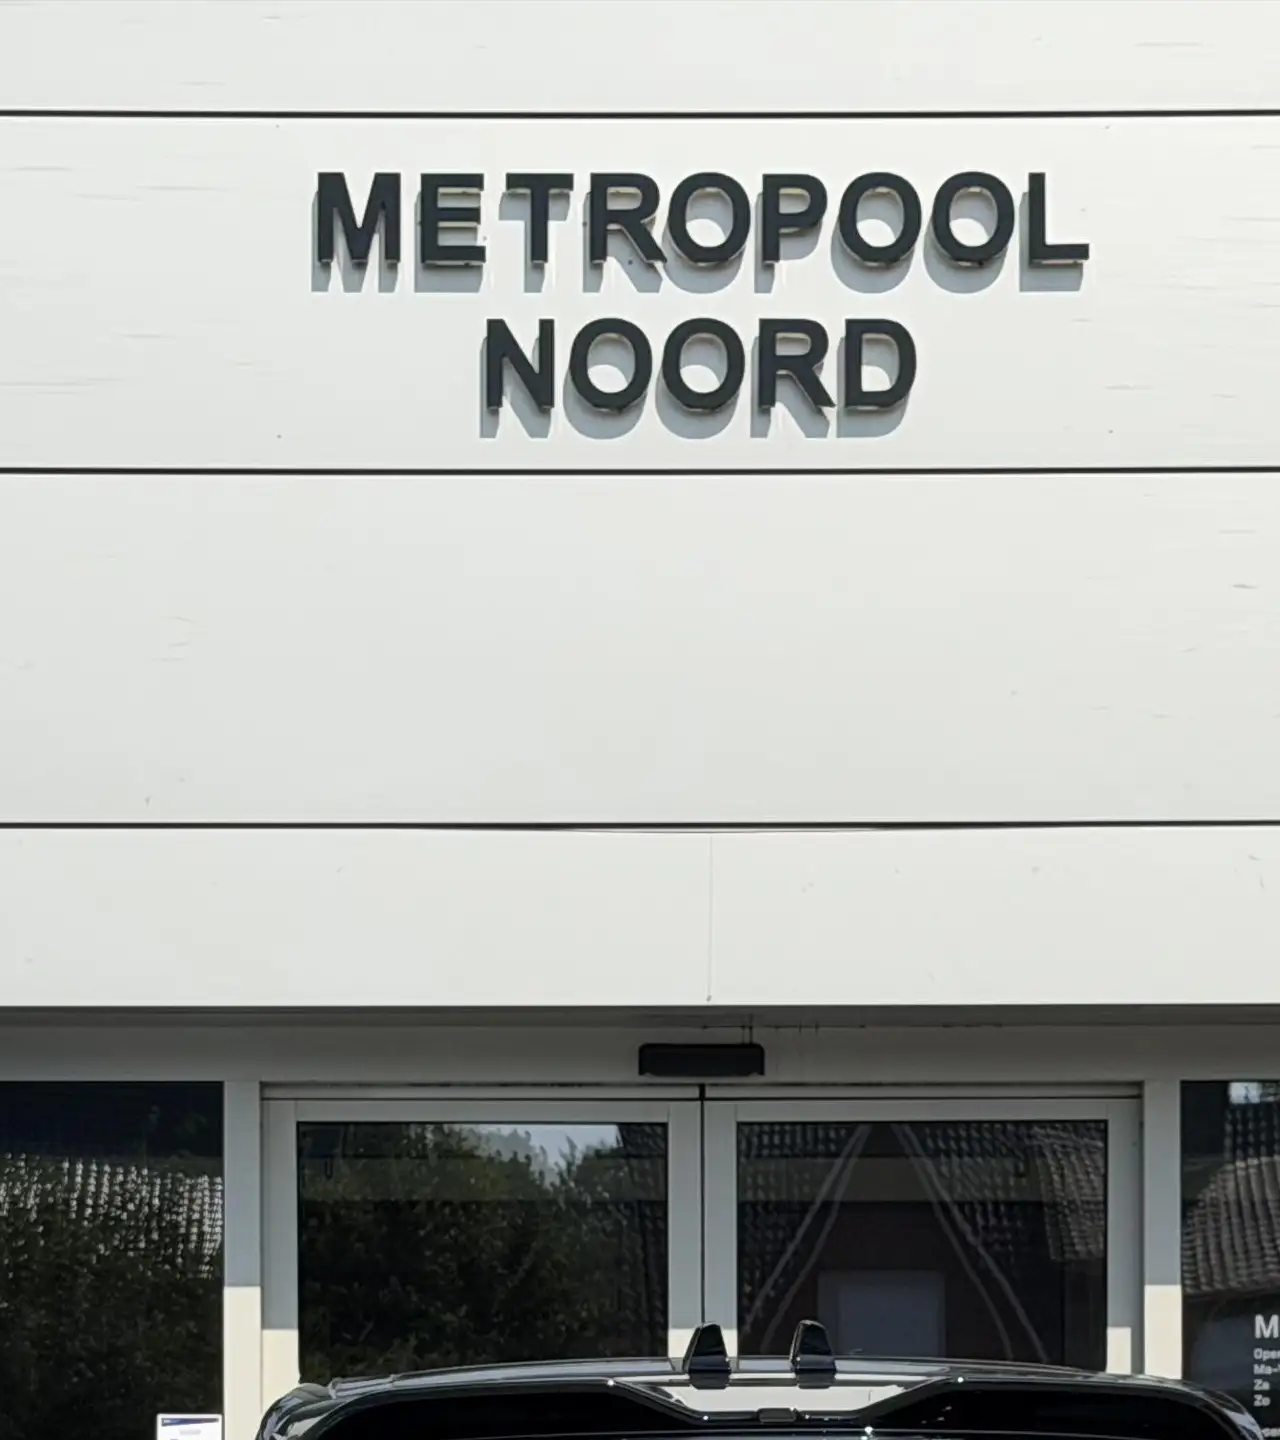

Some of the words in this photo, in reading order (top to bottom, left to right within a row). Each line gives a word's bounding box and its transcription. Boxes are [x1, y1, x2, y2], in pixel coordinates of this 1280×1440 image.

[317, 172, 1090, 266] METROPOOL
[486, 318, 917, 412] NOORD
[1253, 1379, 1270, 1390] Za
